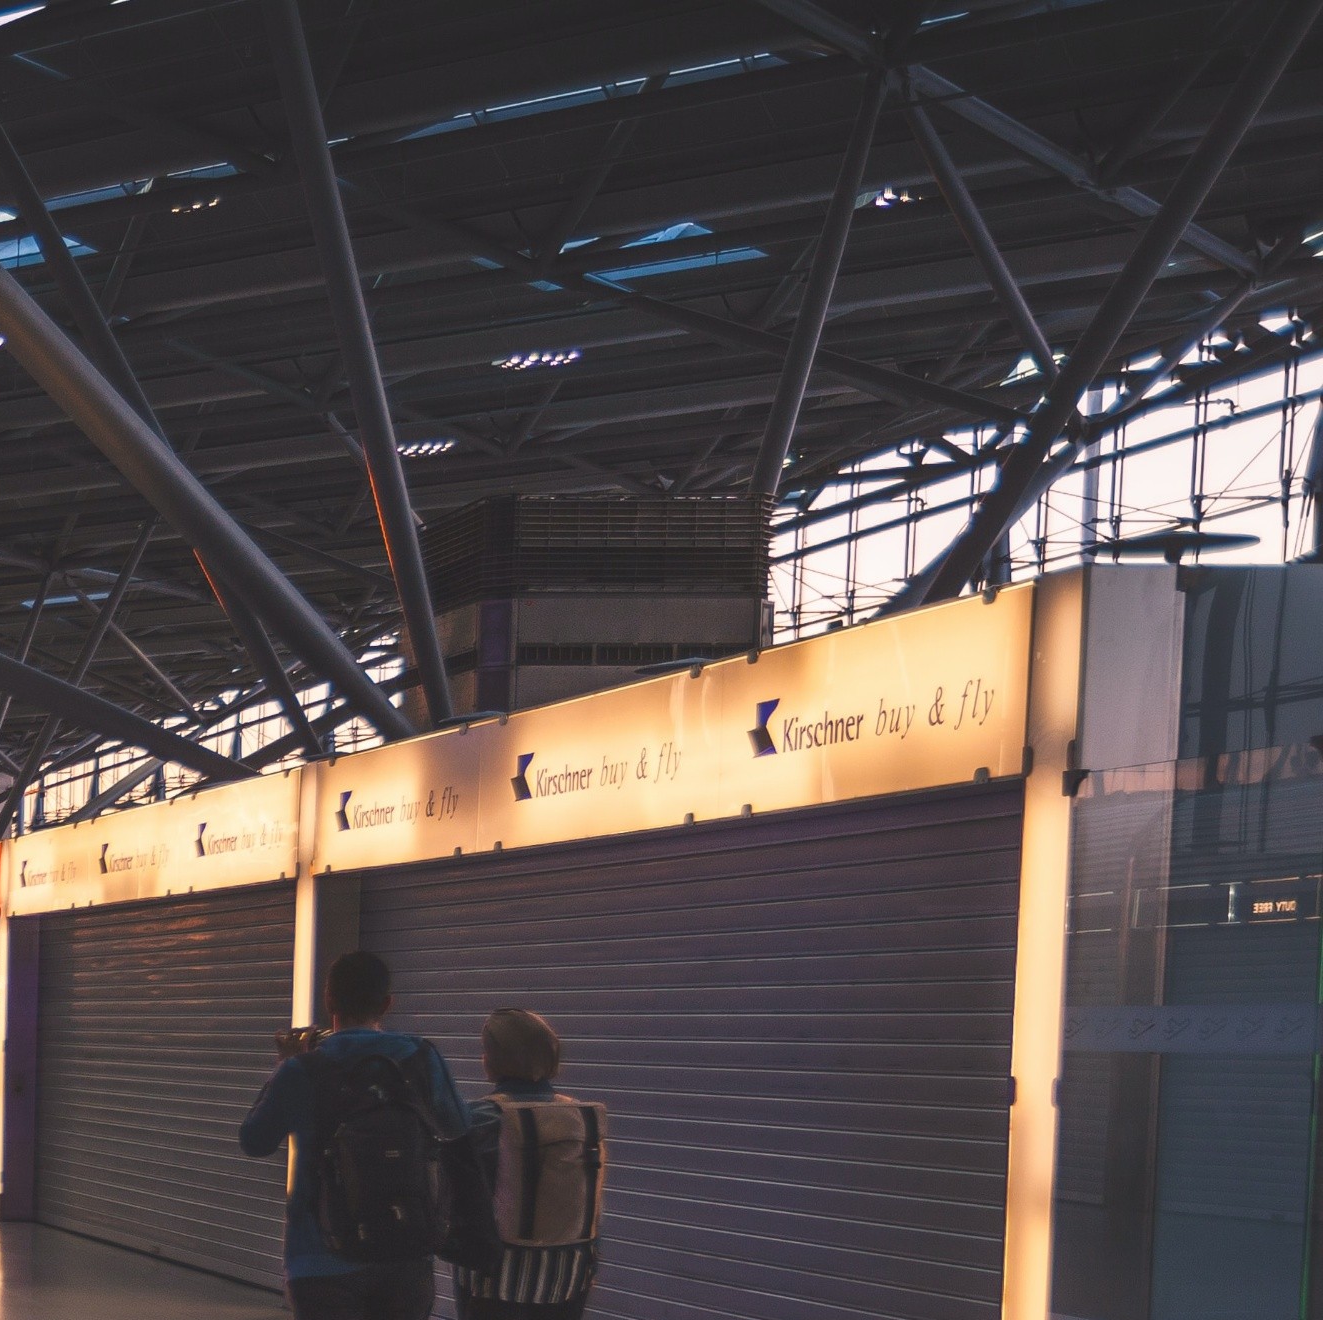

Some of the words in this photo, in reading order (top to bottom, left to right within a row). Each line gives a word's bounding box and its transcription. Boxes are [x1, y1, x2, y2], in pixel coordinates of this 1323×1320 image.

[782, 710, 864, 753] Kirschner
[875, 698, 916, 739] buy
[928, 686, 944, 726] &
[954, 678, 995, 731] fly
[535, 763, 593, 798] Kirschner
[599, 755, 628, 790] buy
[635, 747, 647, 779] &
[653, 742, 681, 784] fly
[352, 803, 394, 829] Kirschner
[399, 795, 420, 824] buy
[425, 790, 434, 817] &
[438, 786, 459, 819] fly
[206, 832, 237, 856] Kirschner
